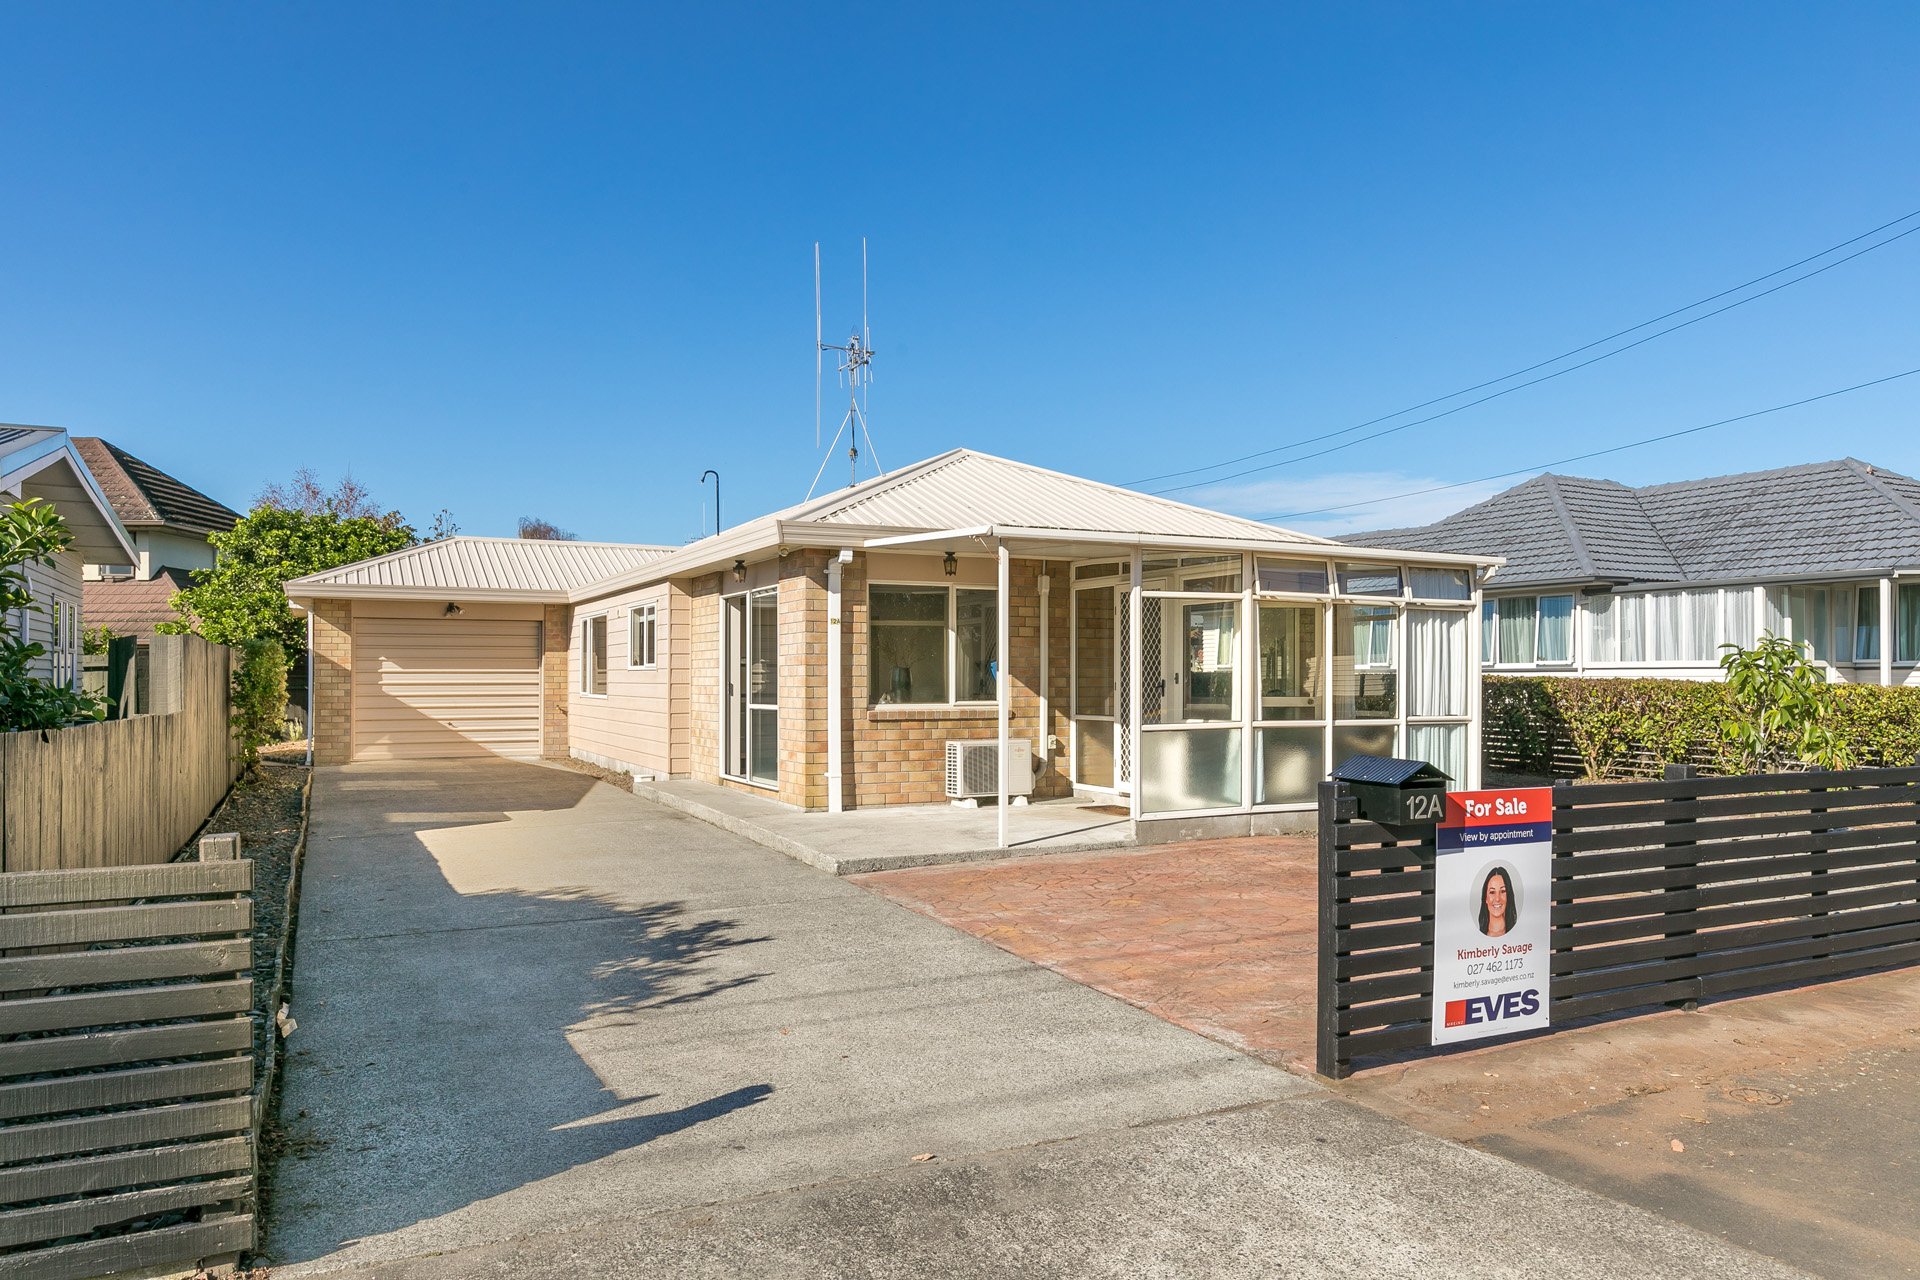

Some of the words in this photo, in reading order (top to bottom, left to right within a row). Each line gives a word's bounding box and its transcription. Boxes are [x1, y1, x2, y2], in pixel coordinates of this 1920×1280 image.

[1406, 794, 1443, 820] 12A
[1465, 799, 1492, 818] For
[1495, 797, 1527, 816] Sale
[1459, 832, 1478, 842] View
[1479, 831, 1488, 842] by
[1489, 829, 1534, 841] appointment
[1457, 945, 1500, 960] Kimberly
[1502, 943, 1533, 955] Savage
[1467, 963, 1484, 975] 027
[1486, 960, 1503, 972] 462
[1505, 957, 1524, 970] 1173
[1453, 972, 1535, 989] kimberly.savage@eves.co.nz
[1465, 989, 1540, 1025] EVES
